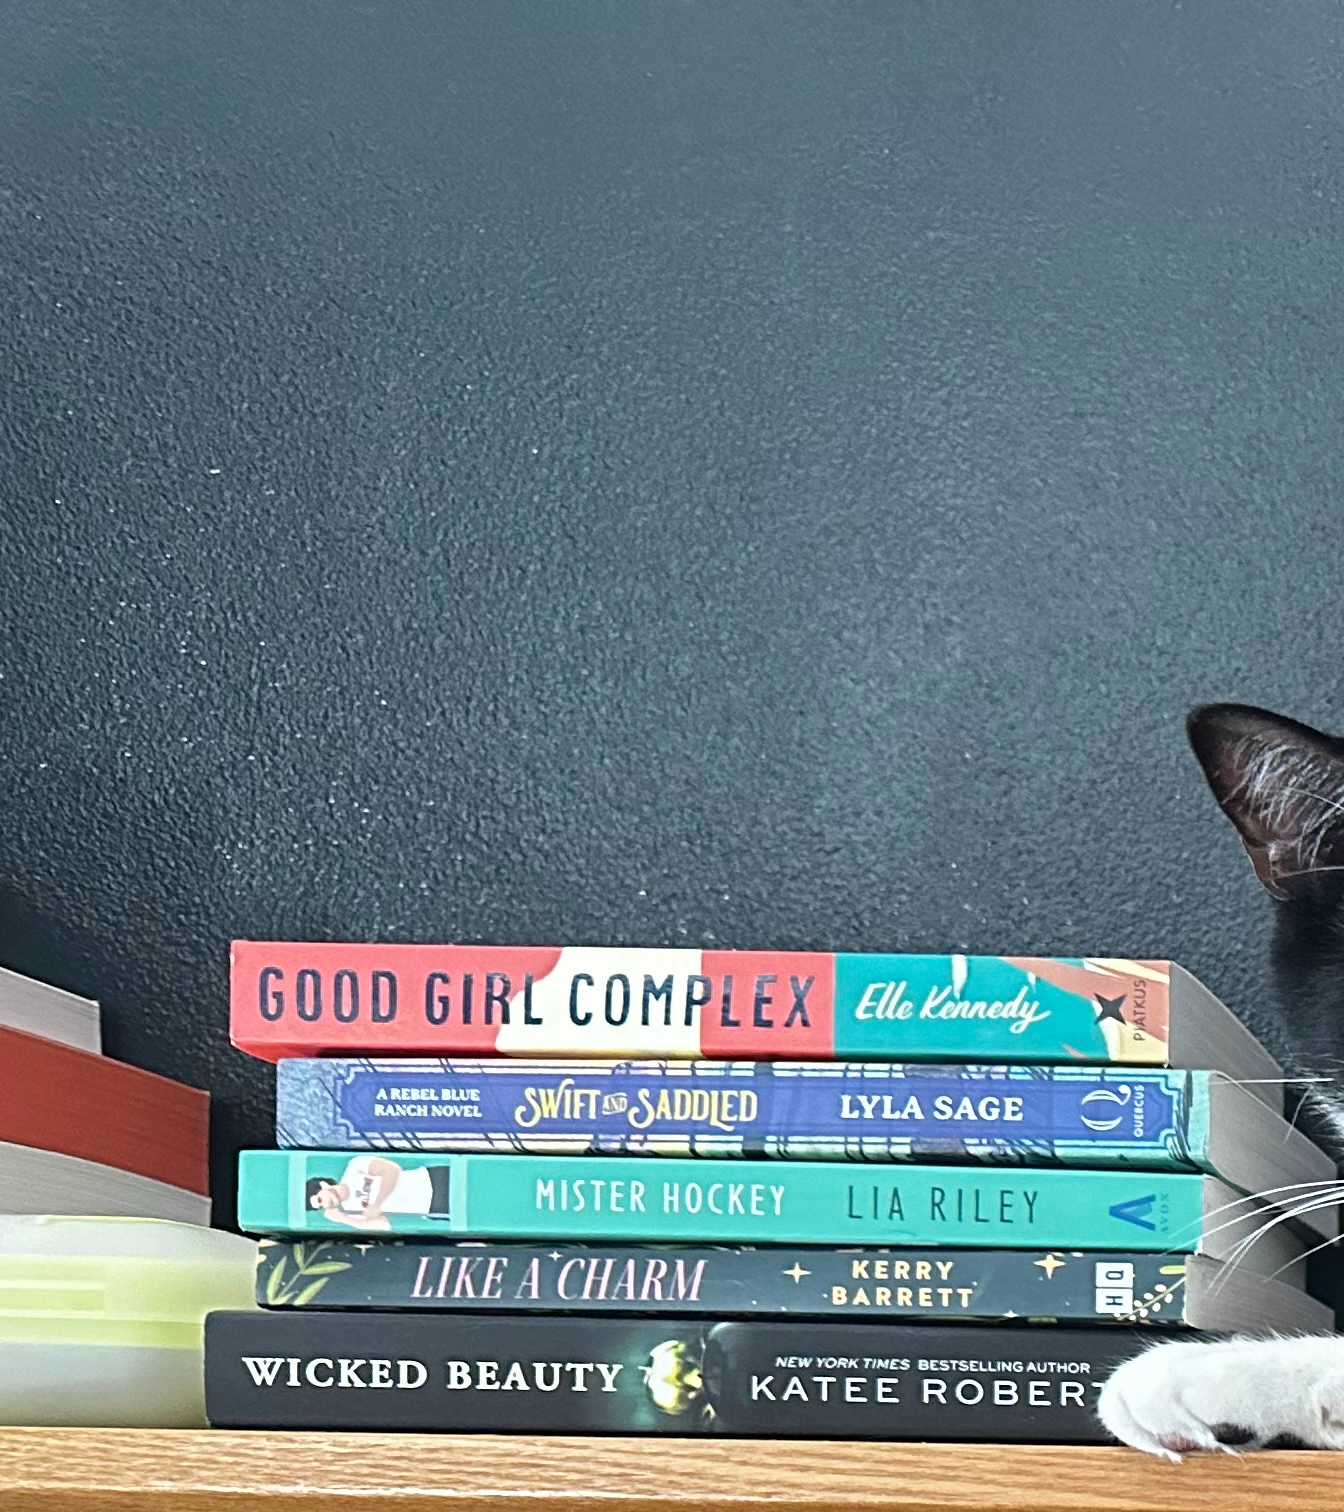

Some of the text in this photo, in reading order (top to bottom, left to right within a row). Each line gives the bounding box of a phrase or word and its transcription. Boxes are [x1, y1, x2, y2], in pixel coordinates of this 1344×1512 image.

[259, 967, 815, 1028] GOOD GIRL COMPLEX
[855, 980, 1052, 1034] Elle Kennedy
[1133, 979, 1147, 1041] PIATKUS
[374, 1104, 482, 1118] RANCH NOVEL
[376, 1088, 480, 1102] A REBEL BLUE
[515, 1079, 757, 1131] SWIFT AND SADDLED
[840, 1095, 1023, 1121] LYLA SAGE
[1133, 1085, 1144, 1137] QUERCUS
[535, 1178, 785, 1216] MISTER HOCKEY
[848, 1185, 1038, 1223] LIA RILEY
[410, 1256, 709, 1301] LIKE A CHARM
[852, 1260, 954, 1280] KERRY
[831, 1286, 973, 1308] BARRETT
[242, 1357, 623, 1392] WICKED BEAUTY
[775, 1356, 1090, 1374] NEW YORK TIMES BESTSELLING AUTHOR
[751, 1375, 900, 1404] KATEE
